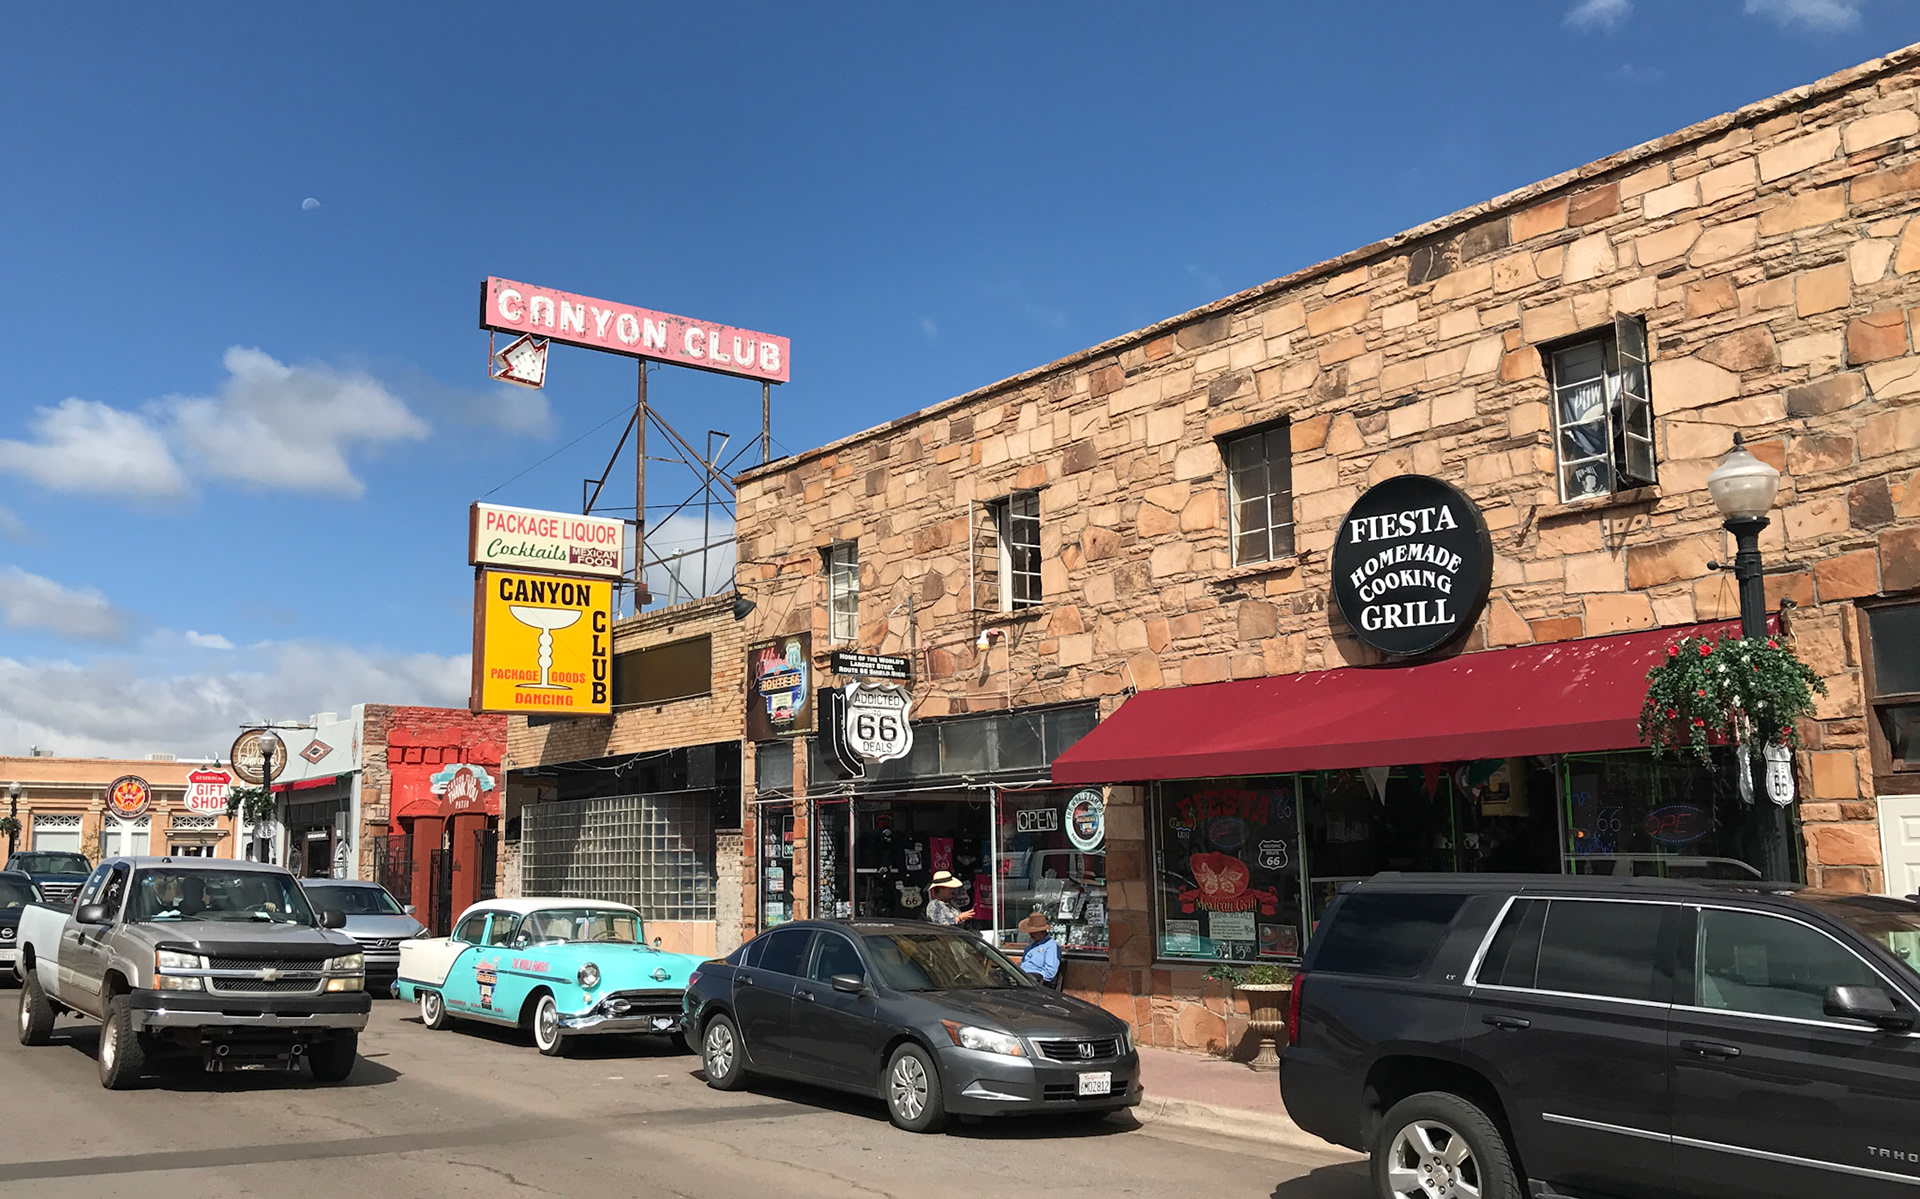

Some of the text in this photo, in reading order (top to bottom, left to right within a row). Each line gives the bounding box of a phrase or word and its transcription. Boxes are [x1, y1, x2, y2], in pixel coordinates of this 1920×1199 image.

[498, 288, 782, 373] CANYON CLUB
[1574, 384, 1602, 417] POW
[486, 511, 616, 545] PACKAGE LIQUOR
[1350, 504, 1459, 544] FIESTA
[487, 538, 567, 561] Cocktails
[572, 547, 617, 560] MEXICAN
[577, 556, 613, 567] FOOD
[1350, 543, 1462, 589] HOMEMADE
[499, 577, 591, 607] CANYON
[1358, 569, 1453, 603] COOKING
[1360, 598, 1456, 631] GRILL
[591, 610, 607, 704] CLUB
[839, 653, 858, 661] HOME
[879, 657, 905, 665] WORLD'S
[850, 660, 895, 671] LARGEST STEEL
[490, 667, 586, 683] PACKAGE GOODS
[838, 666, 859, 674] ROUTE
[859, 667, 869, 675] 66
[891, 670, 906, 678] SIGN
[761, 674, 800, 692] ROUTE 66
[514, 692, 574, 706] DANCING
[854, 692, 900, 706] ADDICTED
[857, 713, 897, 742] 66
[862, 741, 893, 753] DEALS
[196, 784, 225, 796] GIFT
[448, 781, 479, 805] THANK YOU
[1774, 774, 1788, 797] 66
[191, 796, 229, 810] SHOP
[455, 800, 469, 809] PATIO
[1176, 788, 1271, 826] FIESTA
[1019, 811, 1056, 830] OPEN
[1596, 808, 1622, 832] 66
[1645, 812, 1693, 835] OPE
[1266, 856, 1281, 866] 66
[905, 897, 919, 906] 66
[1196, 898, 1259, 912] Mexican Grill
